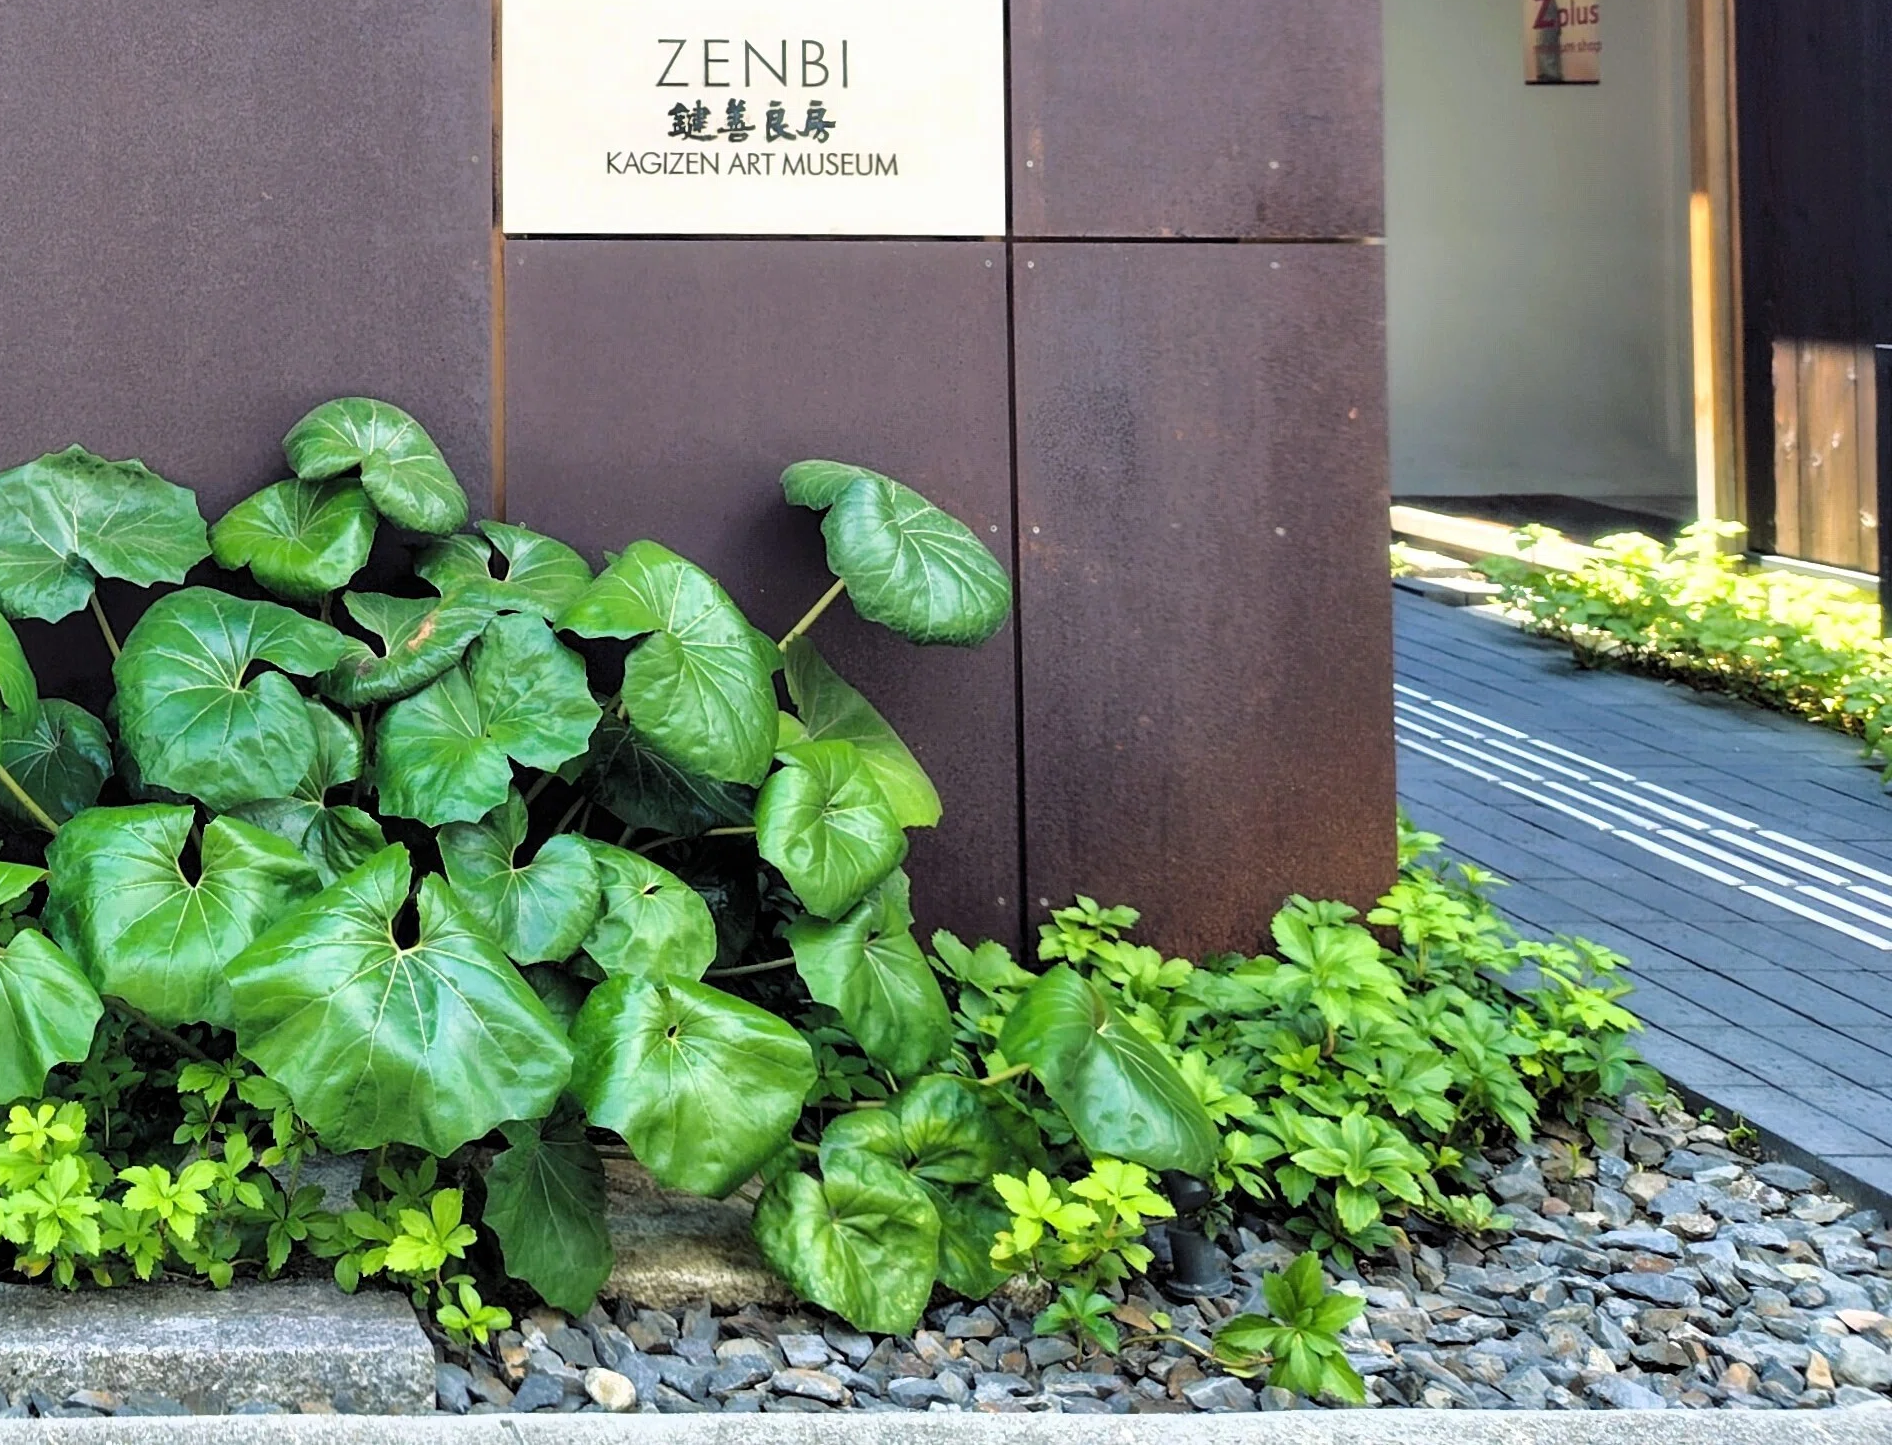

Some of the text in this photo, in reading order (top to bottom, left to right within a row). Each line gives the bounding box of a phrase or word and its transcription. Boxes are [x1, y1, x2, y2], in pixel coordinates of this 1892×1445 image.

[655, 38, 848, 88] ZENBI
[667, 97, 837, 143] 鍵善良房
[606, 151, 899, 176] KAGIZEN ART MUSEUM
